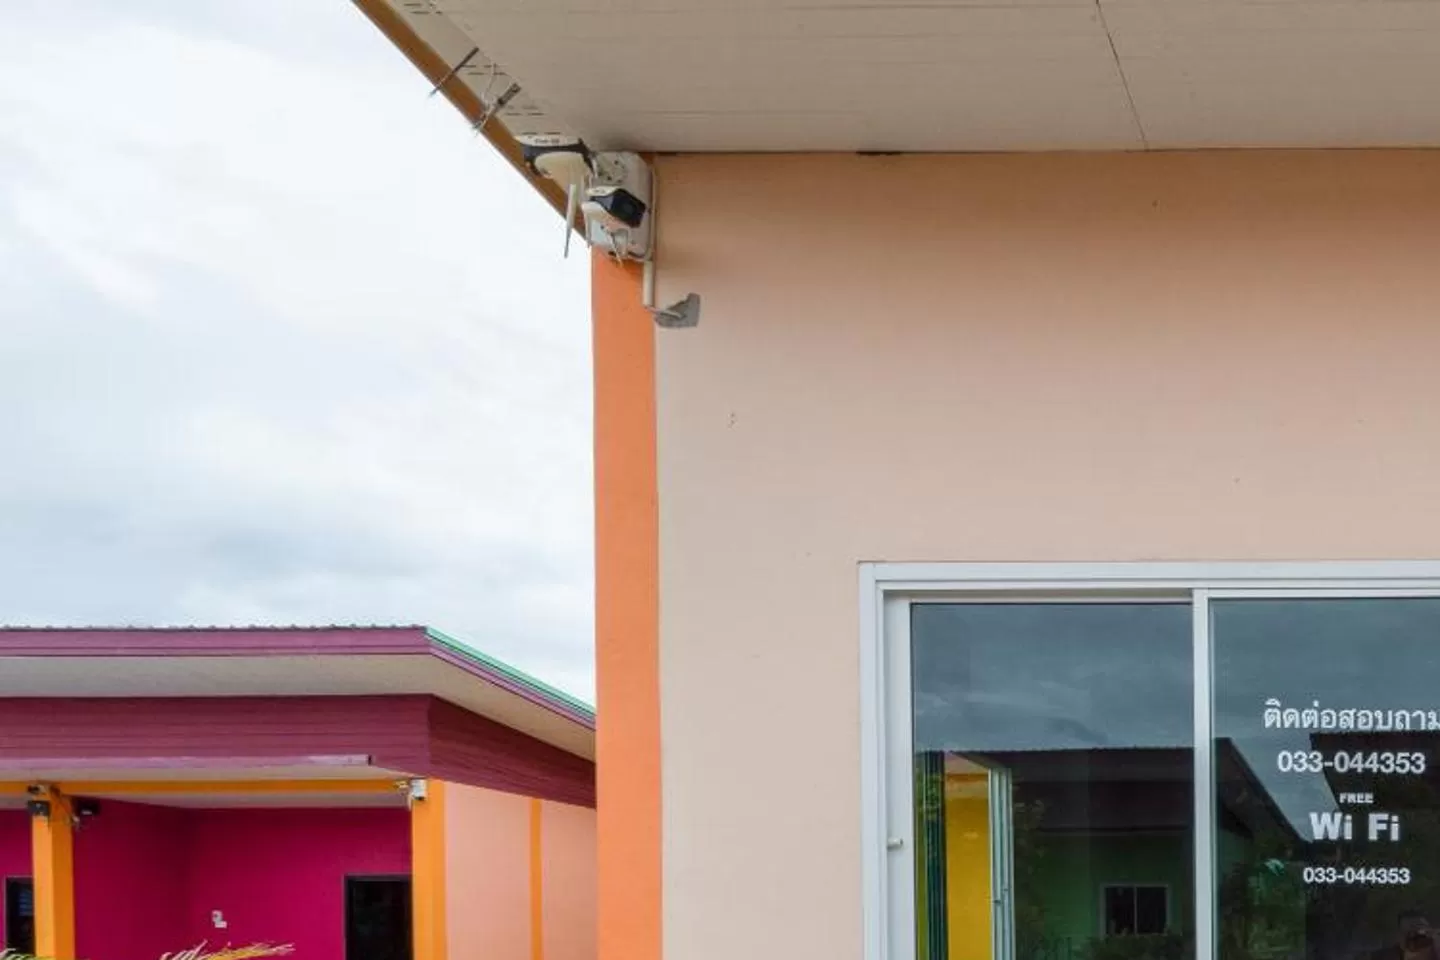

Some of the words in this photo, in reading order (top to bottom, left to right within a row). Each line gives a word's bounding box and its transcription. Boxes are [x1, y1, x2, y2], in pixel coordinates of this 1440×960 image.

[1277, 750, 1426, 774] 033-044353
[1339, 793, 1374, 804] FREE
[1309, 812, 1353, 841] Wi
[1368, 813, 1400, 841] Fi
[1303, 867, 1411, 884] 033-044353
